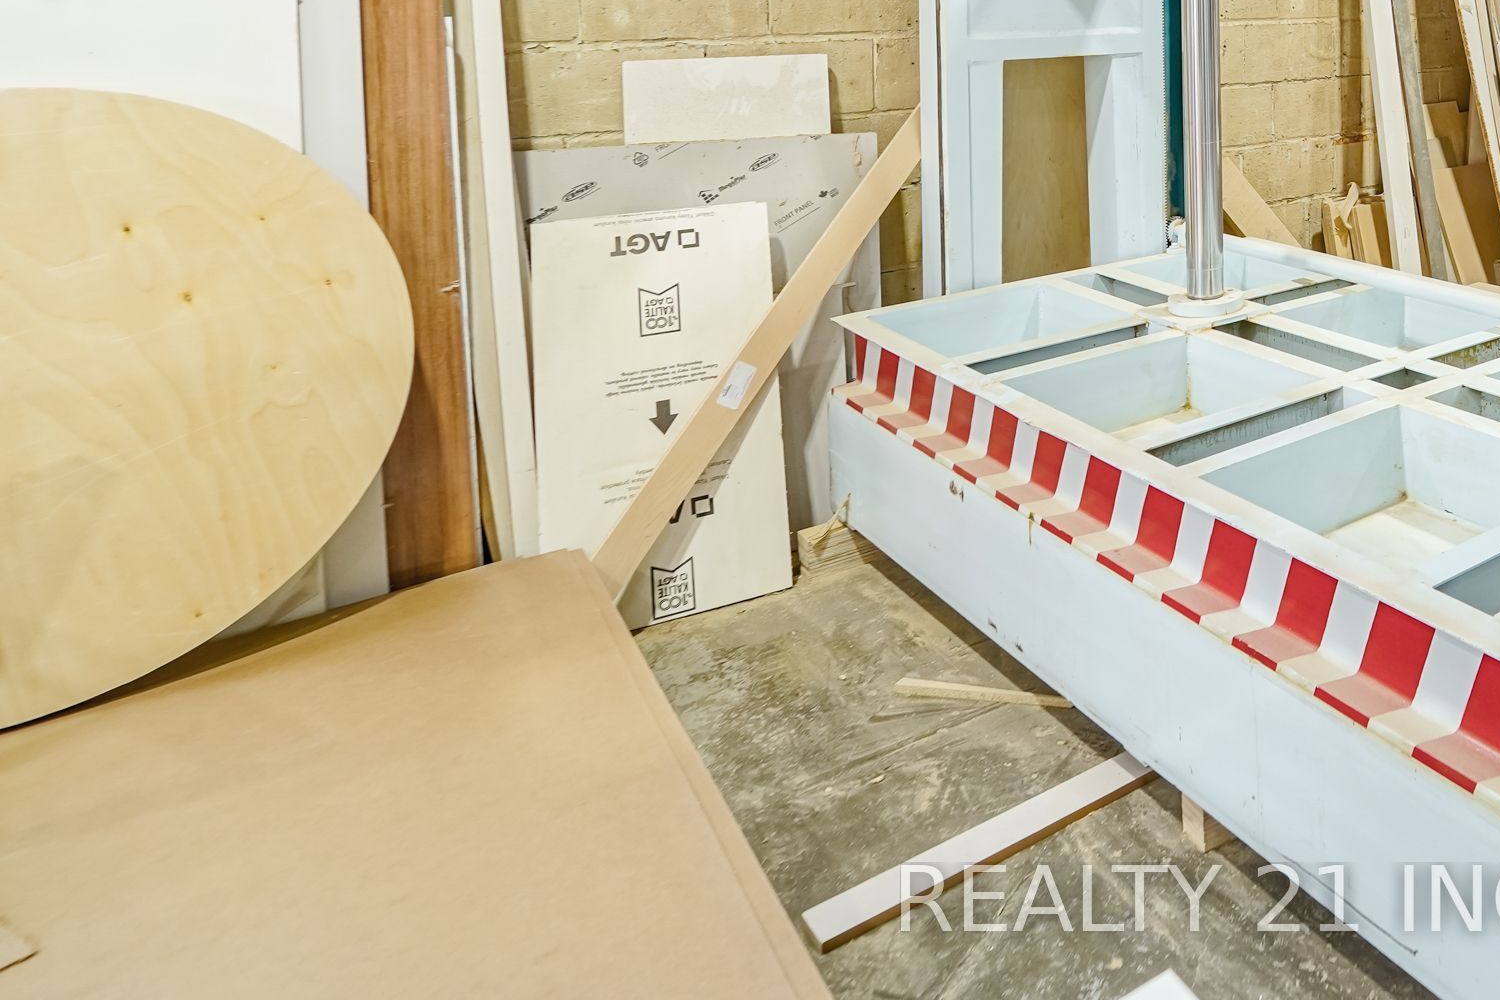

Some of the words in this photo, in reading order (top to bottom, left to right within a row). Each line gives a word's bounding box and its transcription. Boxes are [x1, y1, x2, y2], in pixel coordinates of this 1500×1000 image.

[774, 211, 795, 227] FRONT
[795, 200, 814, 214] PANEL
[610, 231, 671, 257] AGT
[645, 298, 664, 307] AGT
[657, 575, 678, 587] AGT
